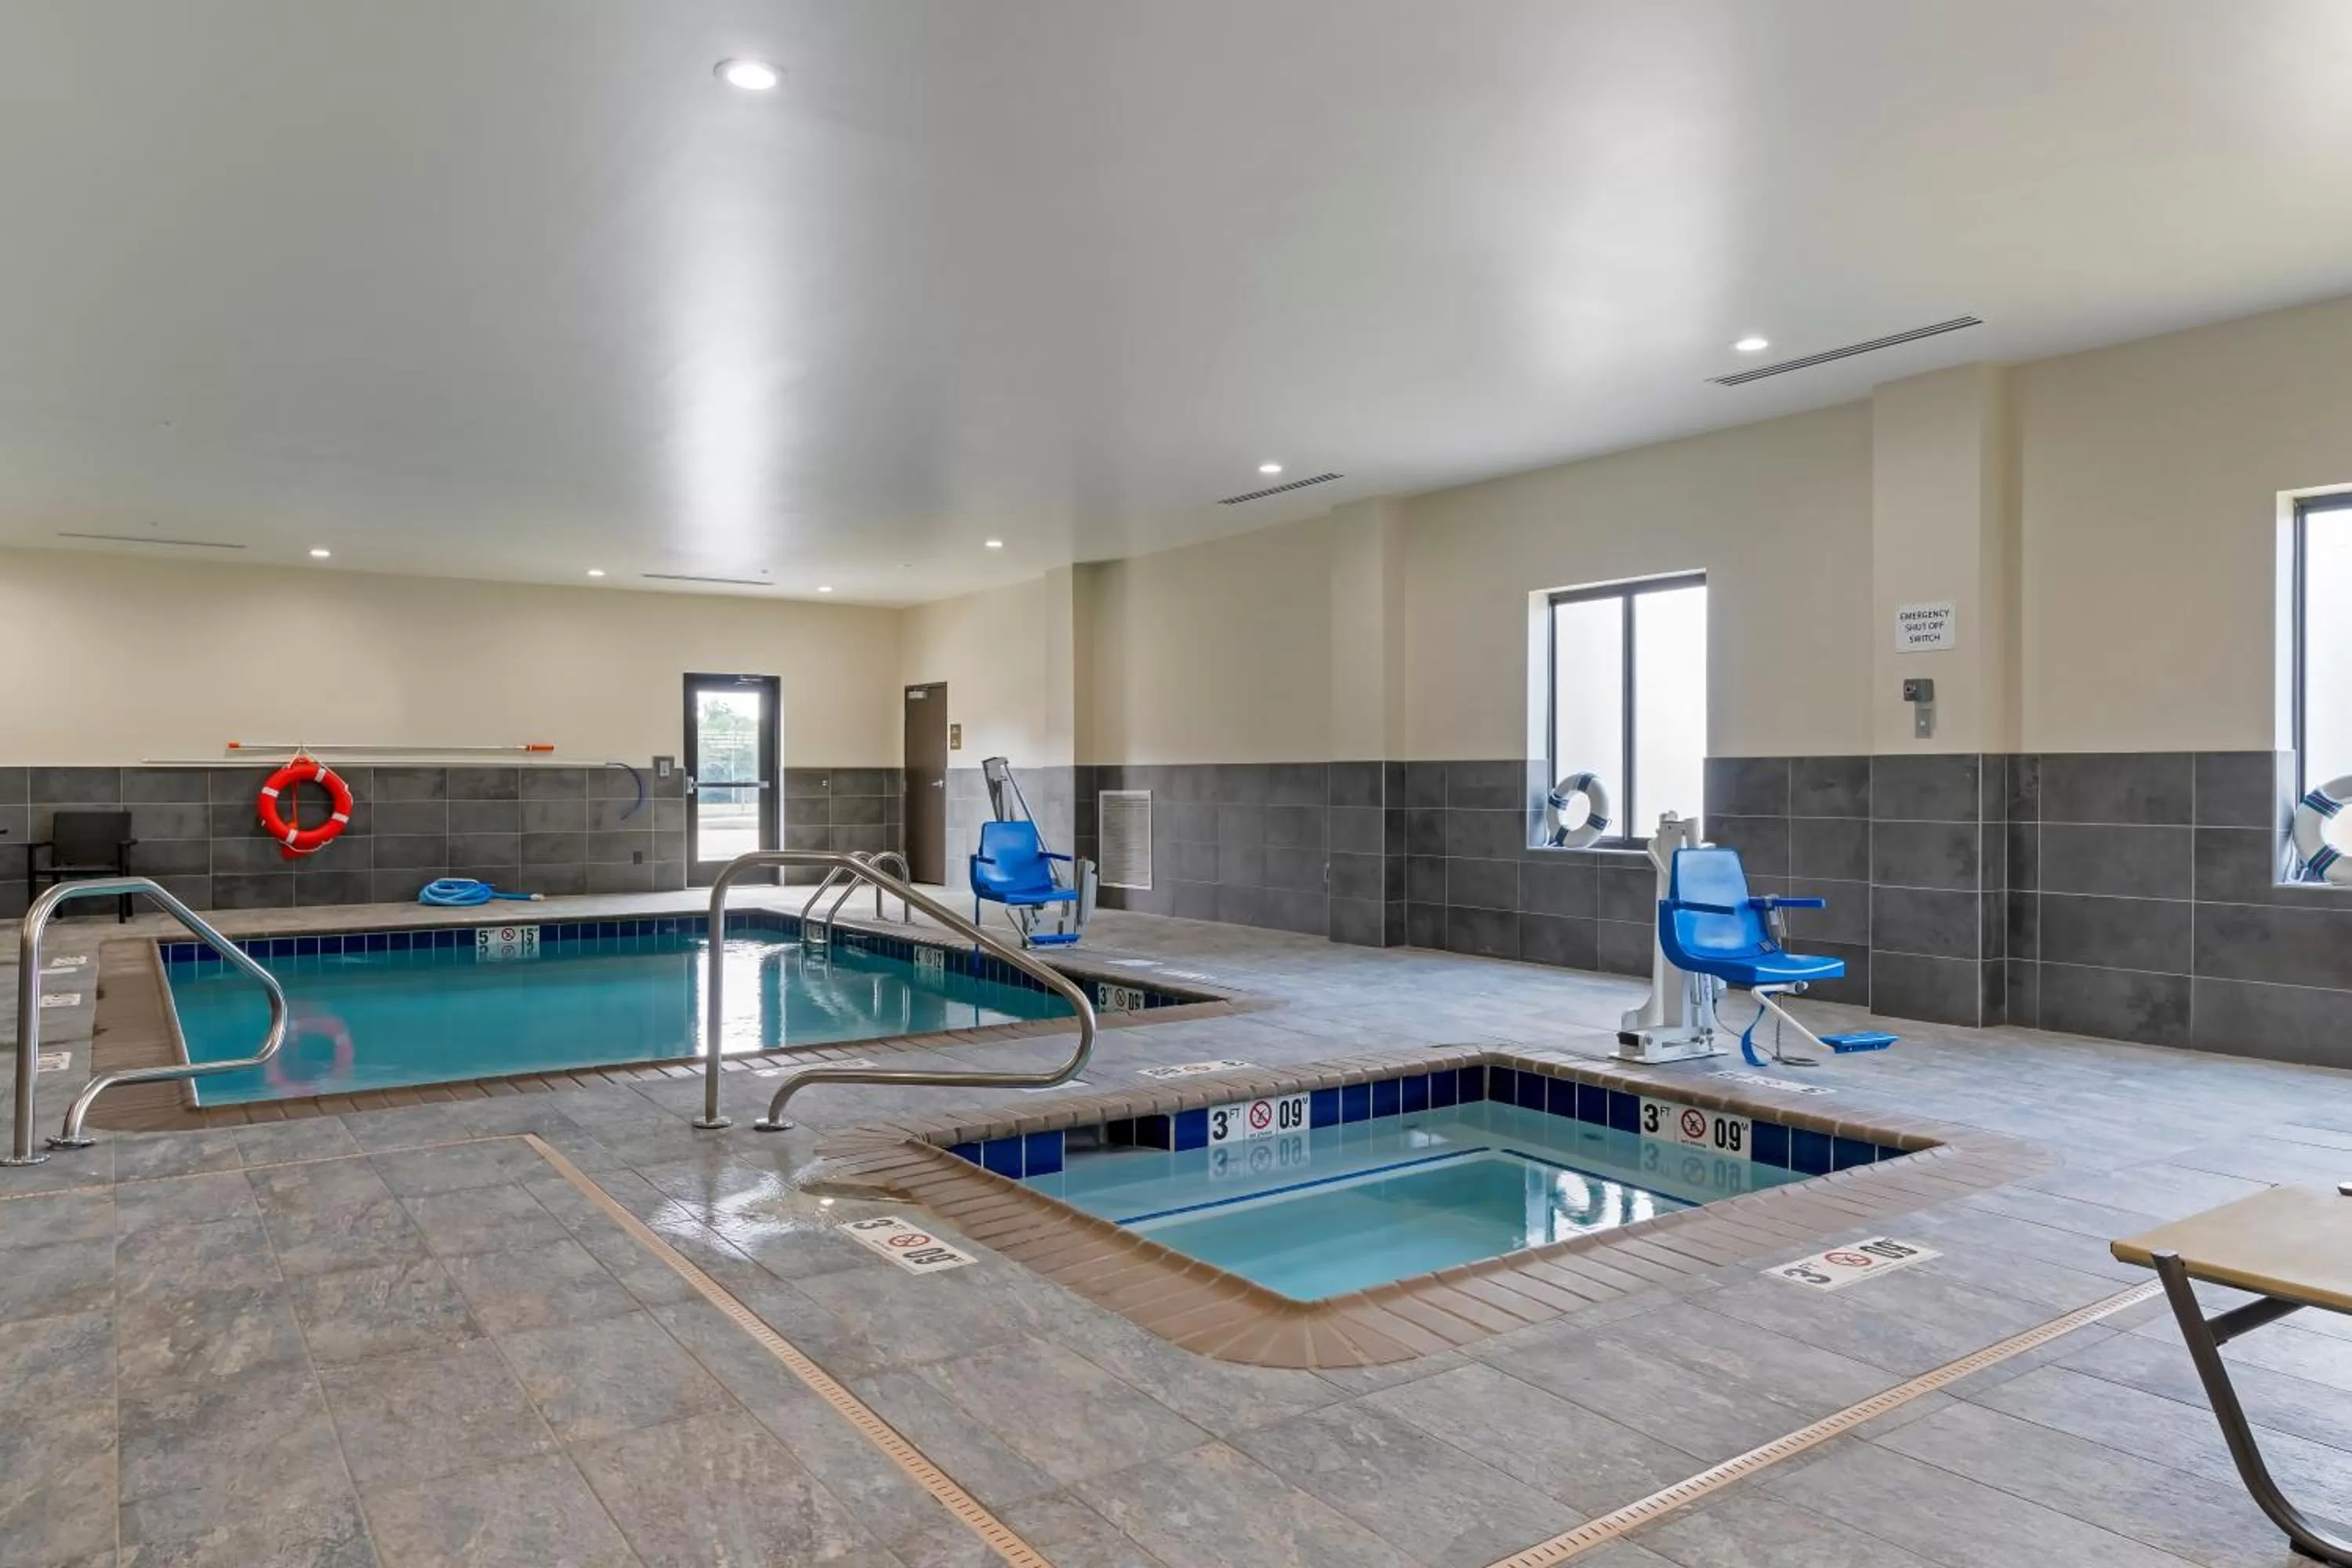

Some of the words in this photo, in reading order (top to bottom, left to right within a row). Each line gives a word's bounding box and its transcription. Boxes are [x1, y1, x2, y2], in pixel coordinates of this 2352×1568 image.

[1900, 609, 1950, 620] EMERGENCY
[1905, 622, 1926, 632] SHUT
[1928, 620, 1944, 630] OFF
[1908, 633, 1940, 644] SWITCH
[478, 930, 488, 944] 5
[1100, 987, 1106, 1005] 3
[1213, 1111, 1229, 1140] 3
[1229, 1108, 1240, 1120] FT
[1644, 1104, 1660, 1133] 3
[1660, 1106, 1671, 1117] FT
